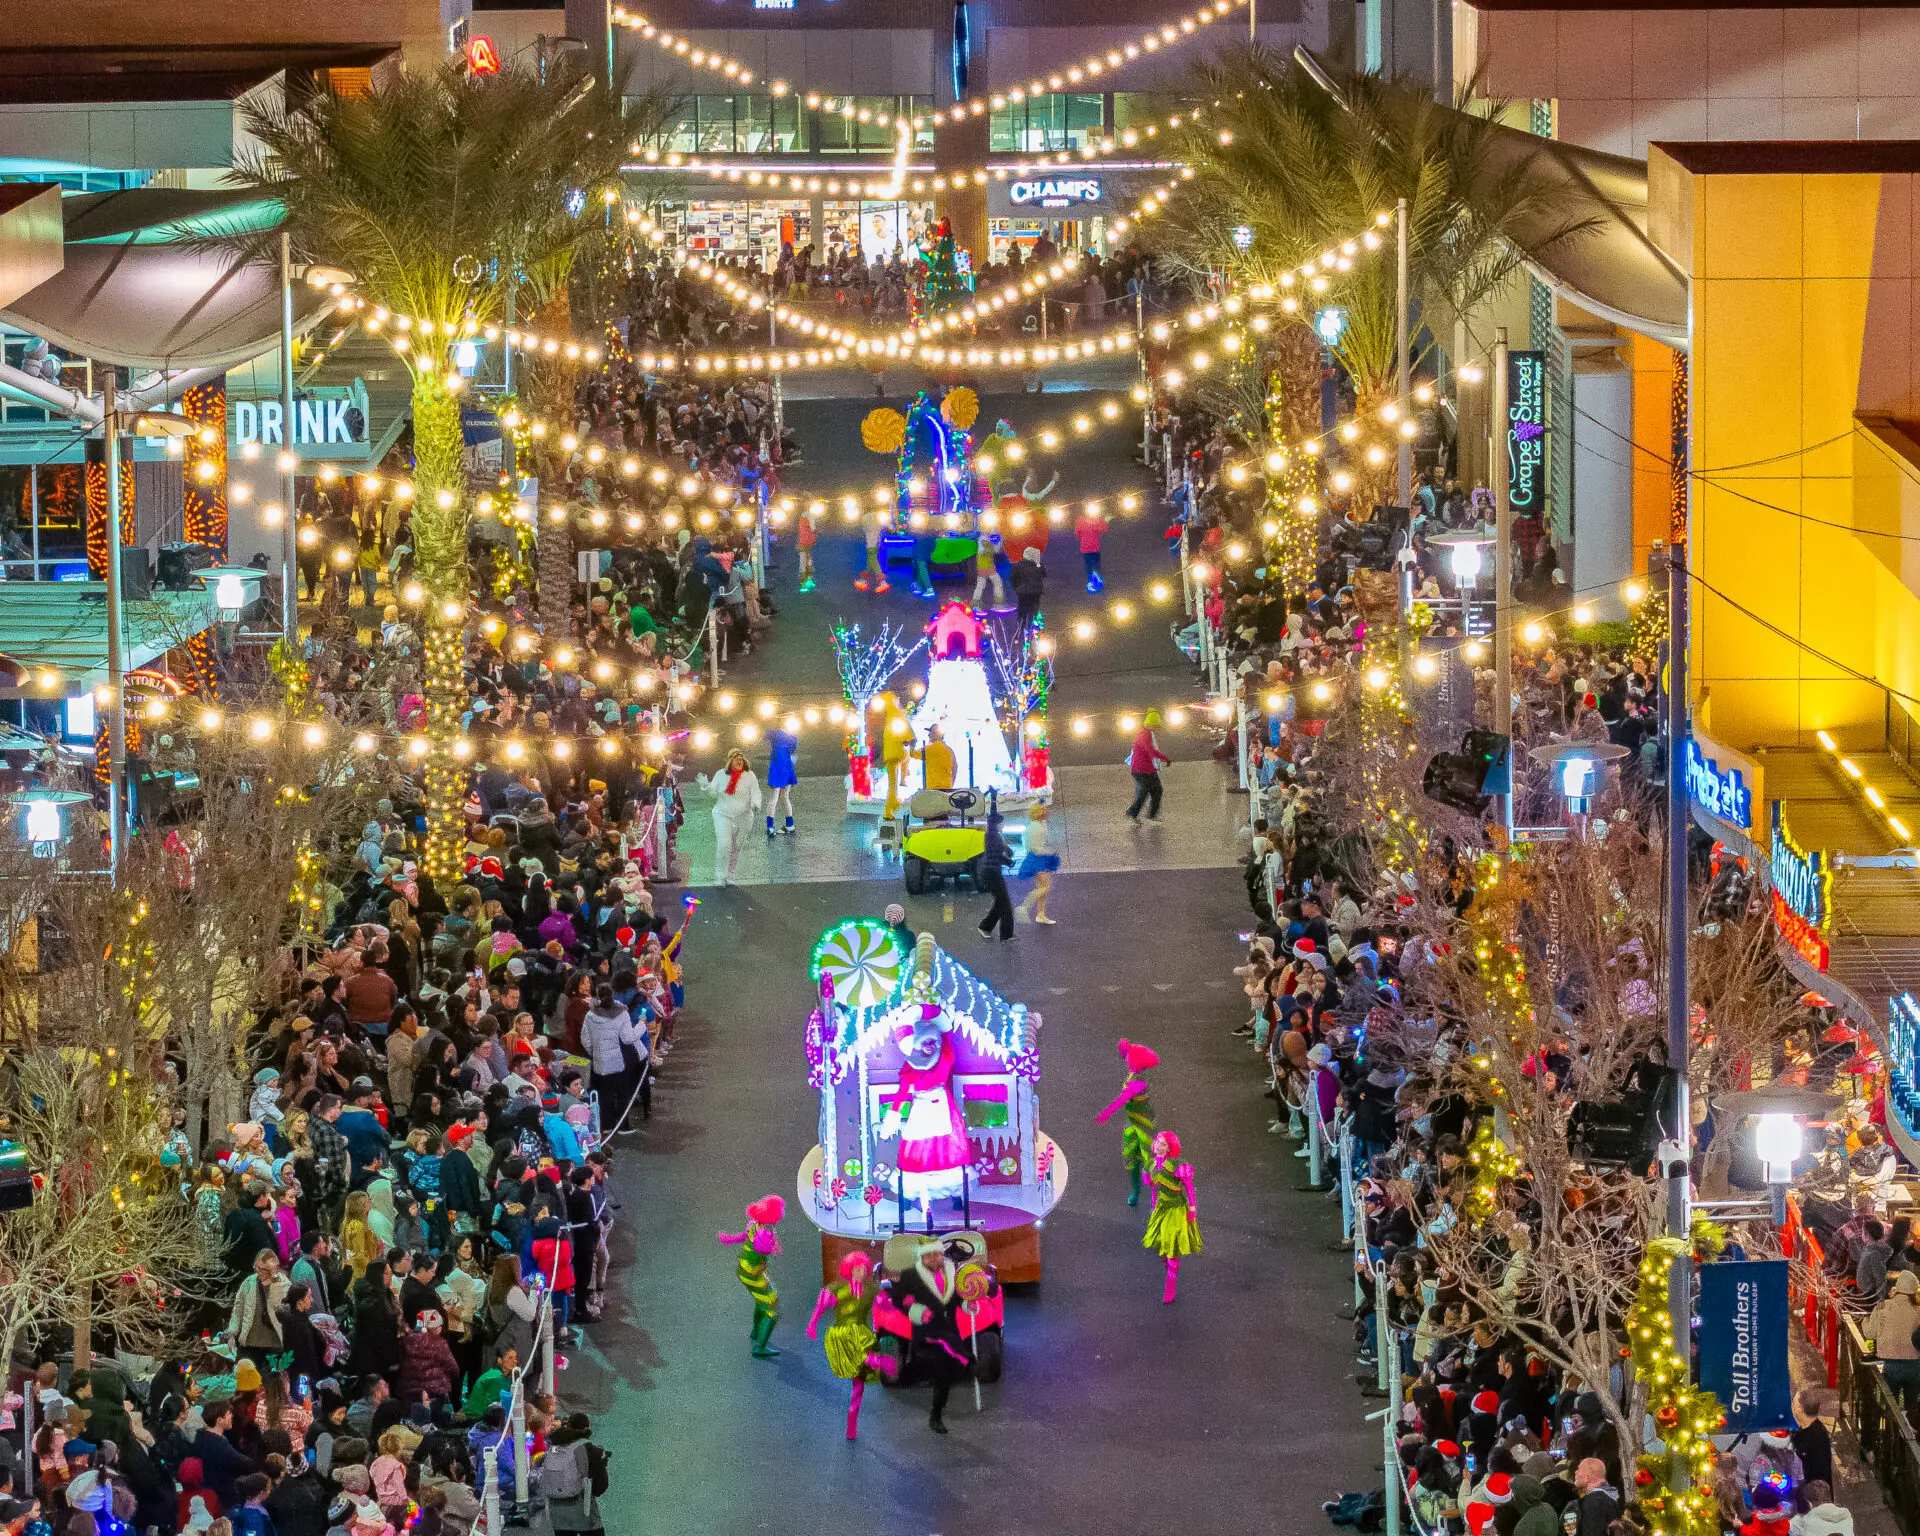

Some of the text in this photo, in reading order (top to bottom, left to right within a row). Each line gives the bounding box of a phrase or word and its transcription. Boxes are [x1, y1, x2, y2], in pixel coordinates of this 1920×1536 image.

[1010, 180, 1101, 202] CHAMPS
[235, 400, 353, 445] DRINK
[1508, 357, 1540, 505] Grape Street
[123, 676, 166, 693] ATTORIA
[1732, 1282, 1750, 1413] Toll Brothers
